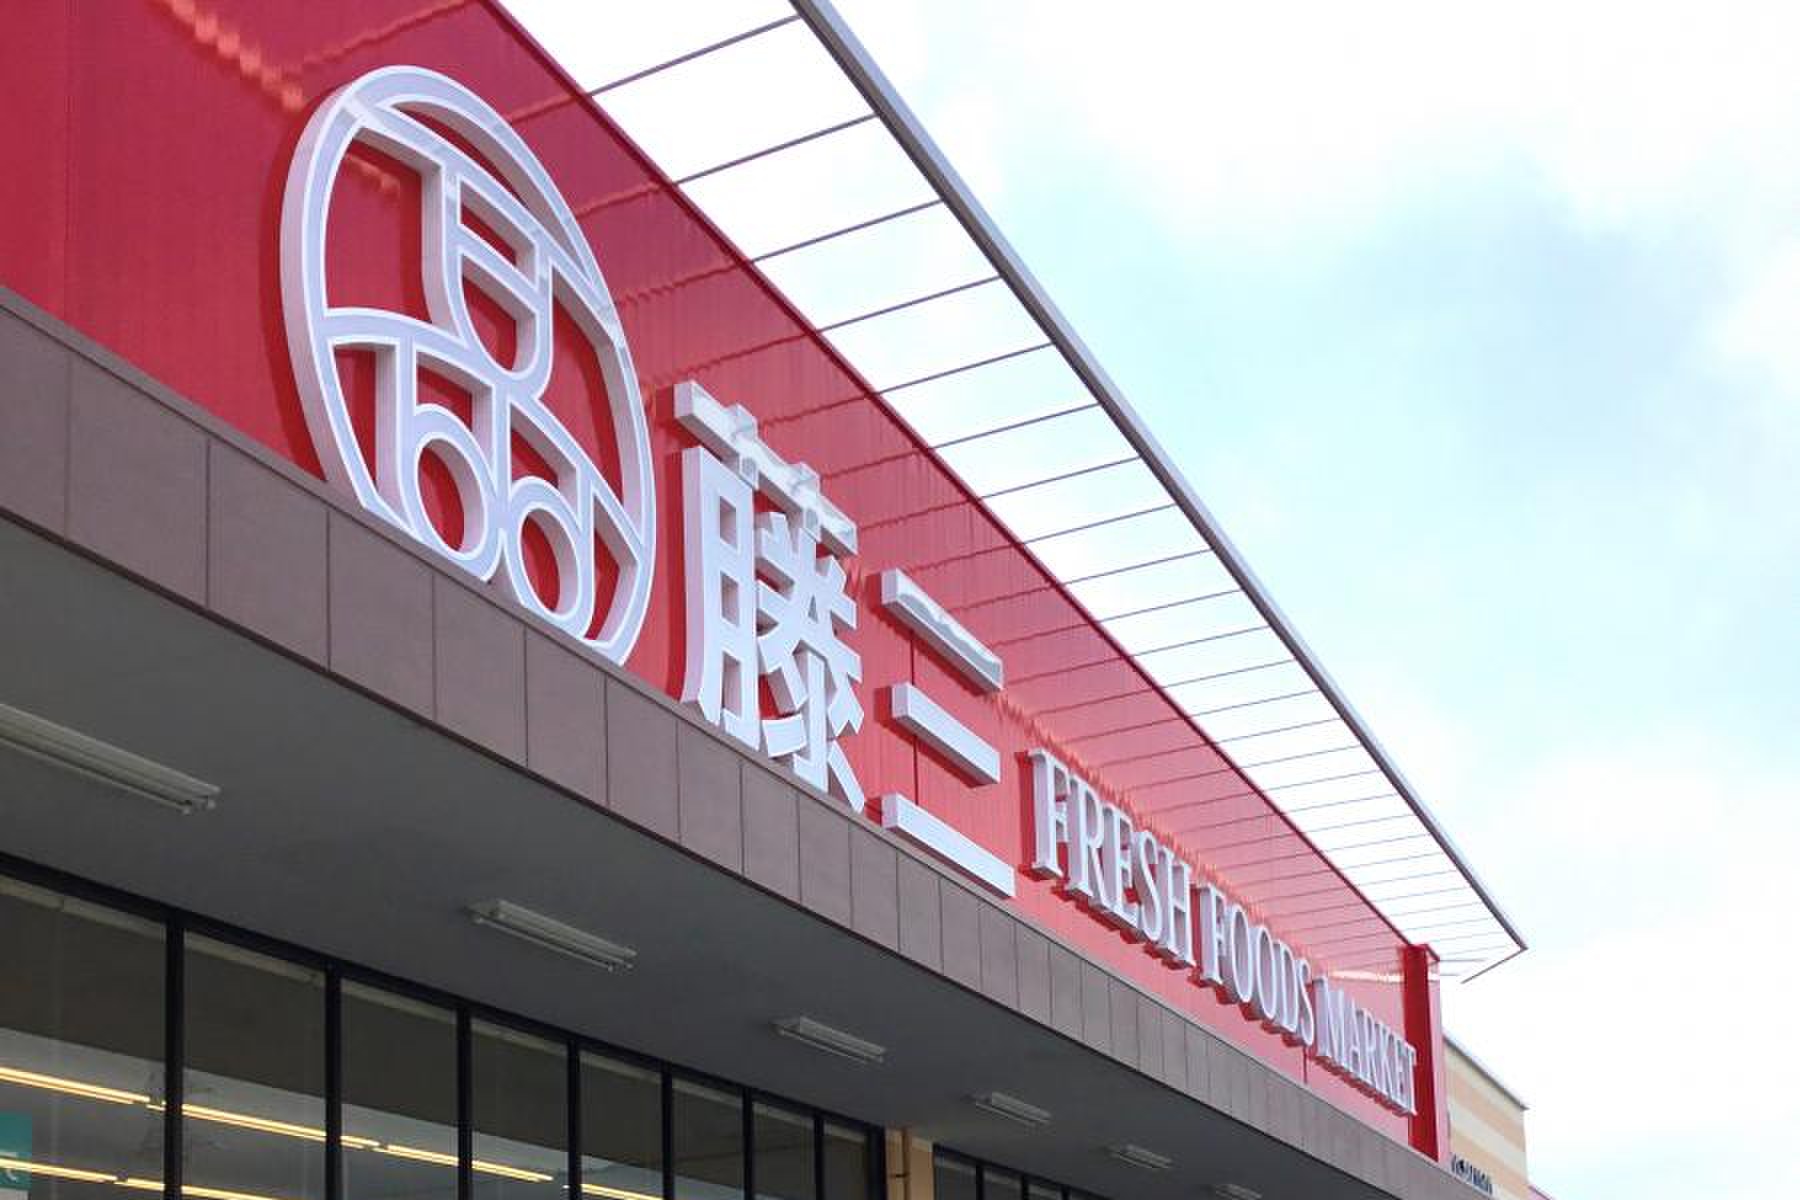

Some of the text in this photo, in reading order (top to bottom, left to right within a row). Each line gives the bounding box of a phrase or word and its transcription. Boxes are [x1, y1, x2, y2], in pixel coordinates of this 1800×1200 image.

[674, 378, 1016, 898] 藤三
[1028, 748, 1417, 1116] FRESH FOODS MARKET
